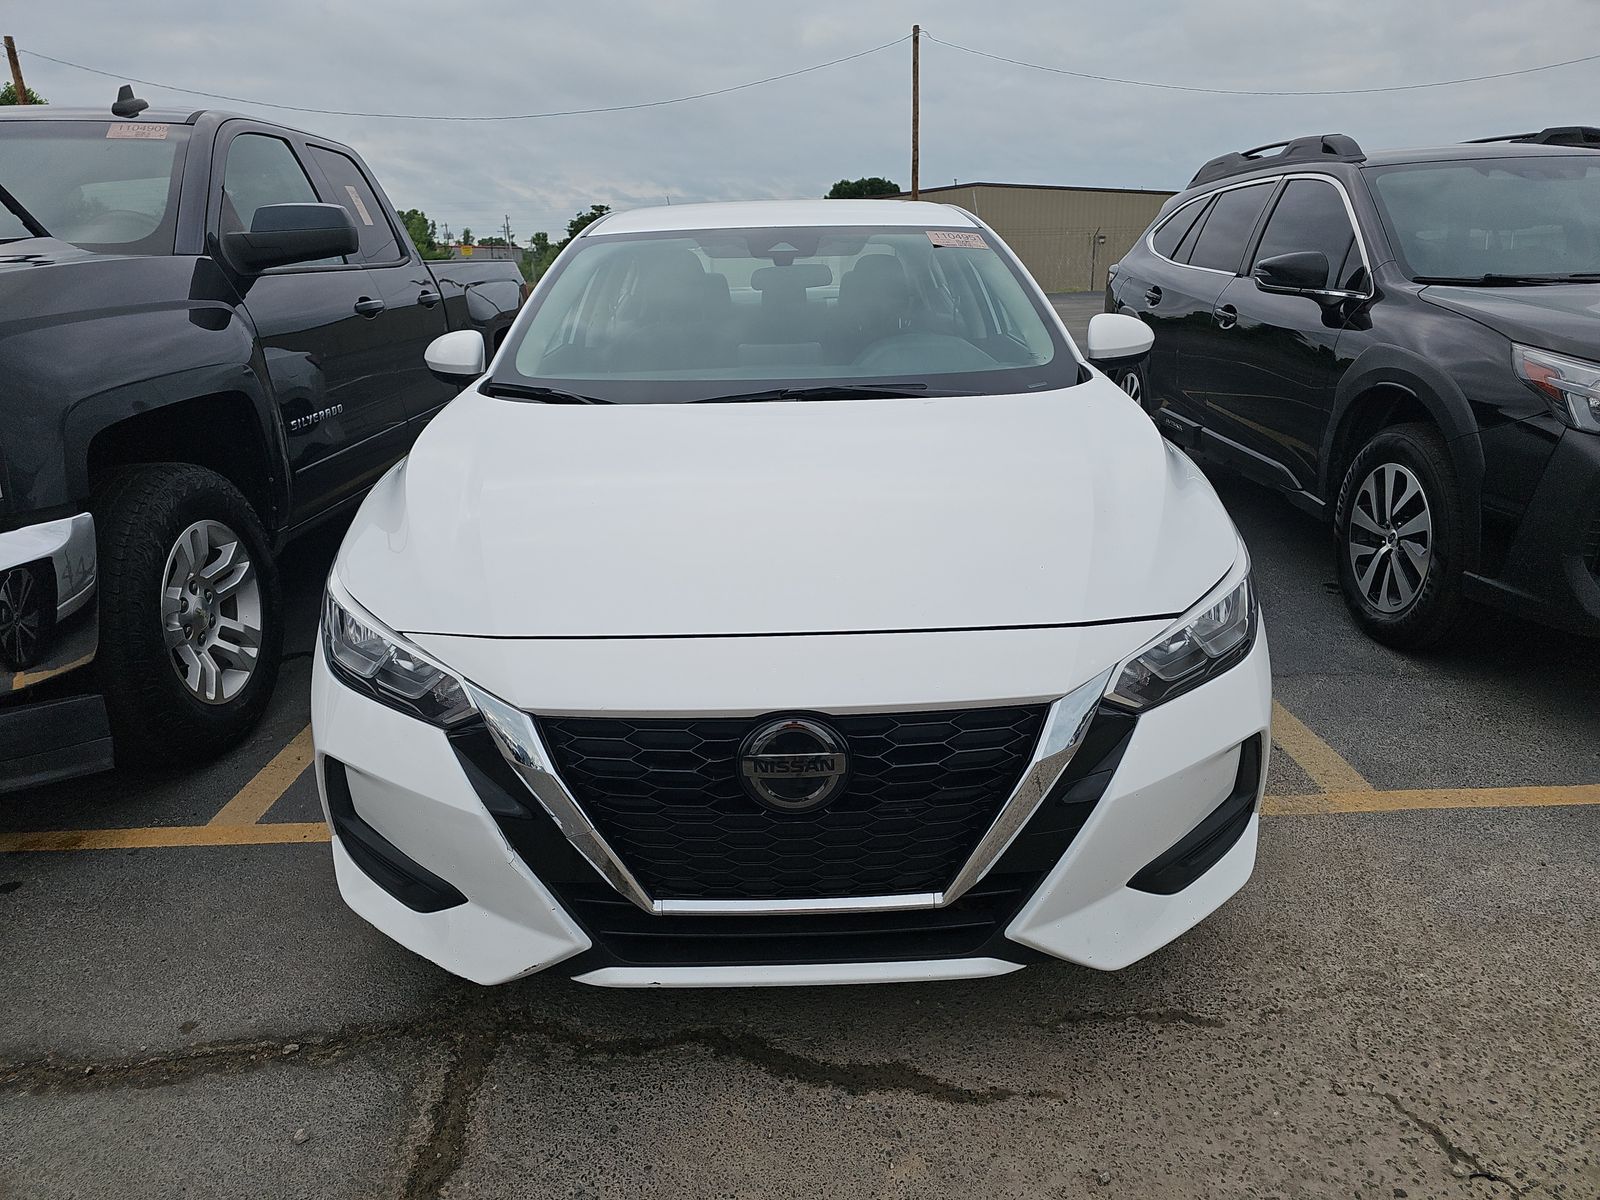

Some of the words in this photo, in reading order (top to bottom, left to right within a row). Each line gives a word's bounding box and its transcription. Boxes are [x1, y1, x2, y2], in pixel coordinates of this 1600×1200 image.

[934, 232, 982, 241] 1104951
[290, 403, 343, 431] SILVERADO
[753, 758, 836, 773] NISSAN
